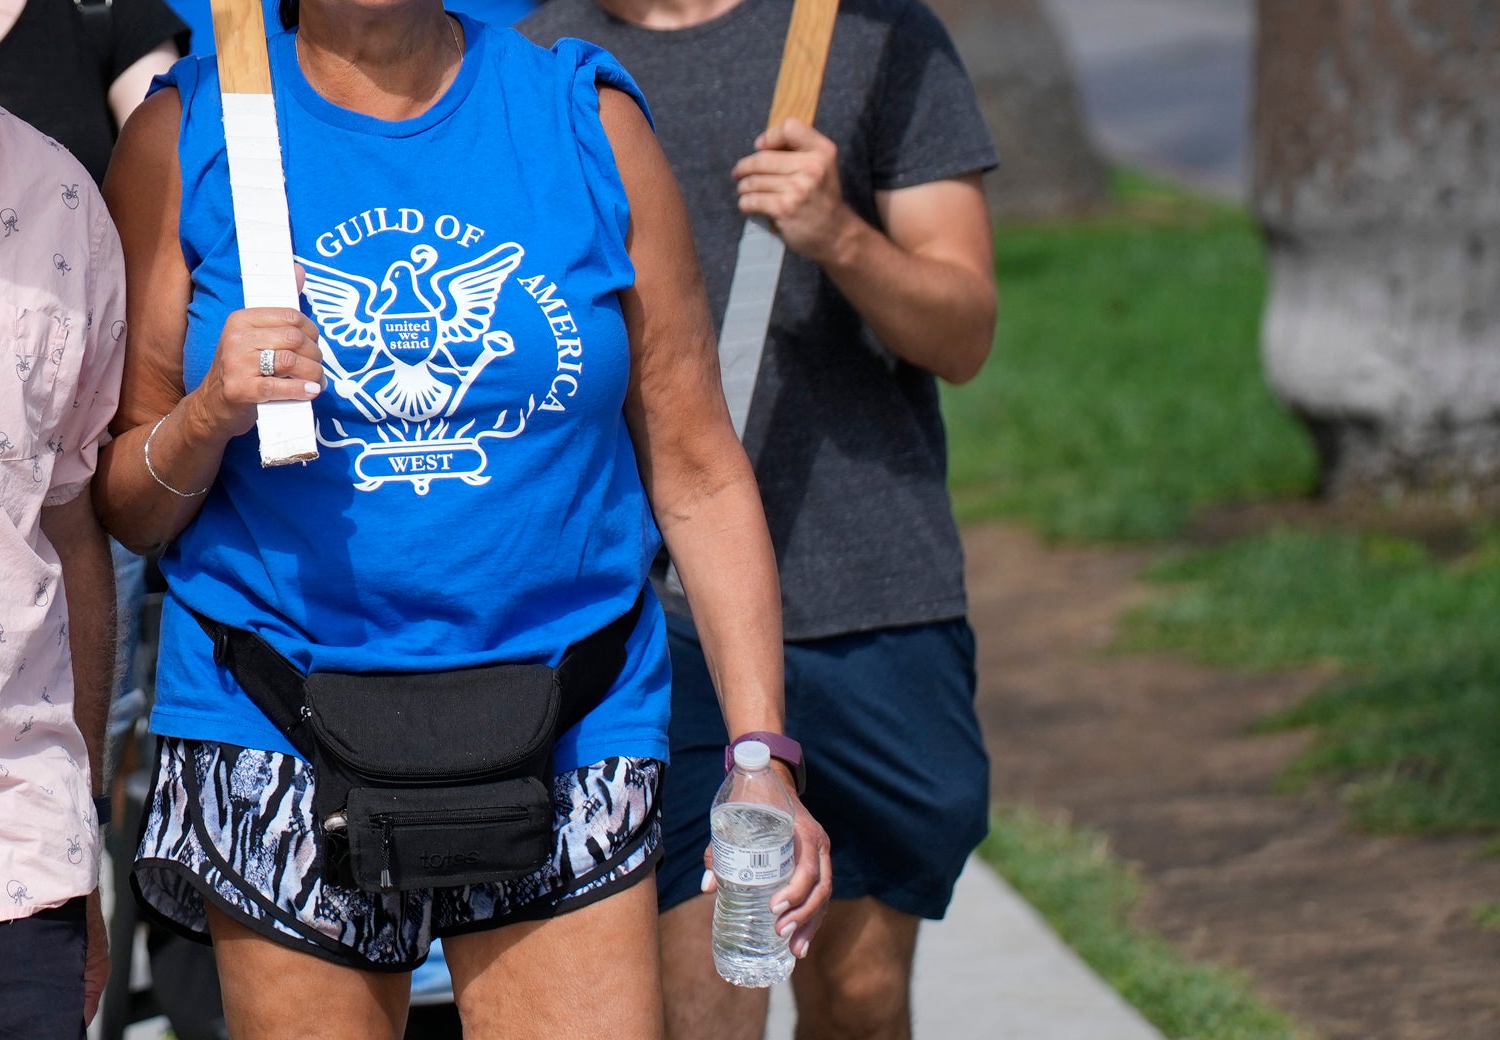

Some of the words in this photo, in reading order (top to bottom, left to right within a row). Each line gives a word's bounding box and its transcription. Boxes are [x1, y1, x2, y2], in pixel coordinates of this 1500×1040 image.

[315, 208, 424, 257] GUILD
[434, 215, 485, 248] OF
[517, 274, 583, 412] AMERICA
[385, 319, 431, 332] united
[399, 332, 419, 340] we
[390, 337, 430, 350] stand
[388, 453, 453, 473] WEST
